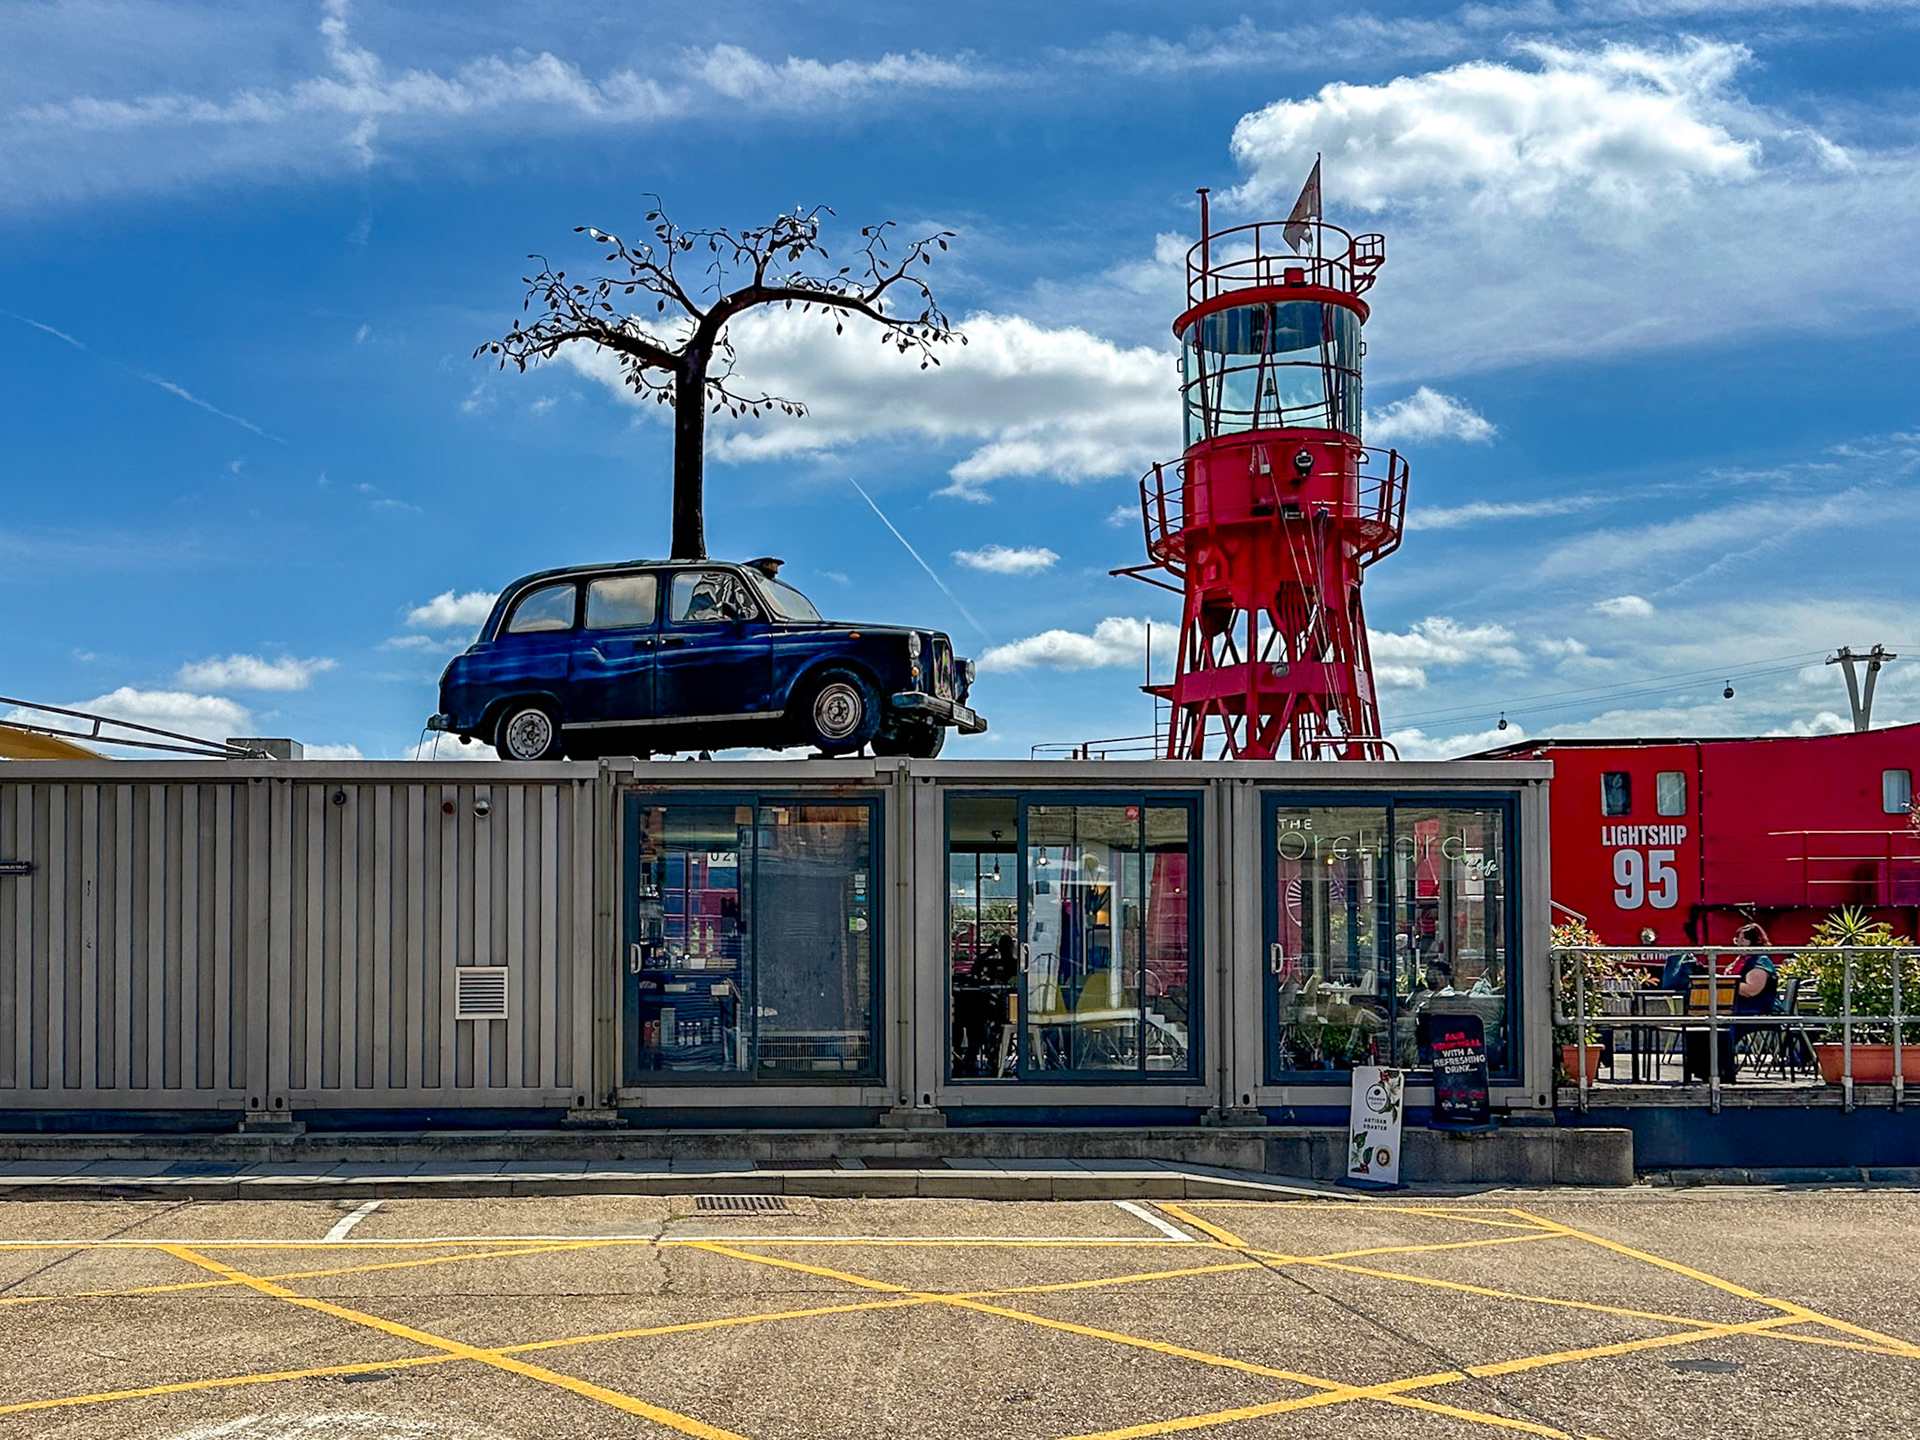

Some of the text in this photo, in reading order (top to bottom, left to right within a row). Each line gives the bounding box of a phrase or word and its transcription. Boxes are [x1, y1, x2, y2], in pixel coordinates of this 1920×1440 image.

[1278, 818, 1313, 830] THE
[1602, 825, 1687, 846] LIGHTSHIP
[1277, 828, 1467, 861] Orchard
[1613, 848, 1678, 910] 95
[1433, 1054, 1486, 1067] REFRESHING
[1441, 1047, 1475, 1058] WITH A
